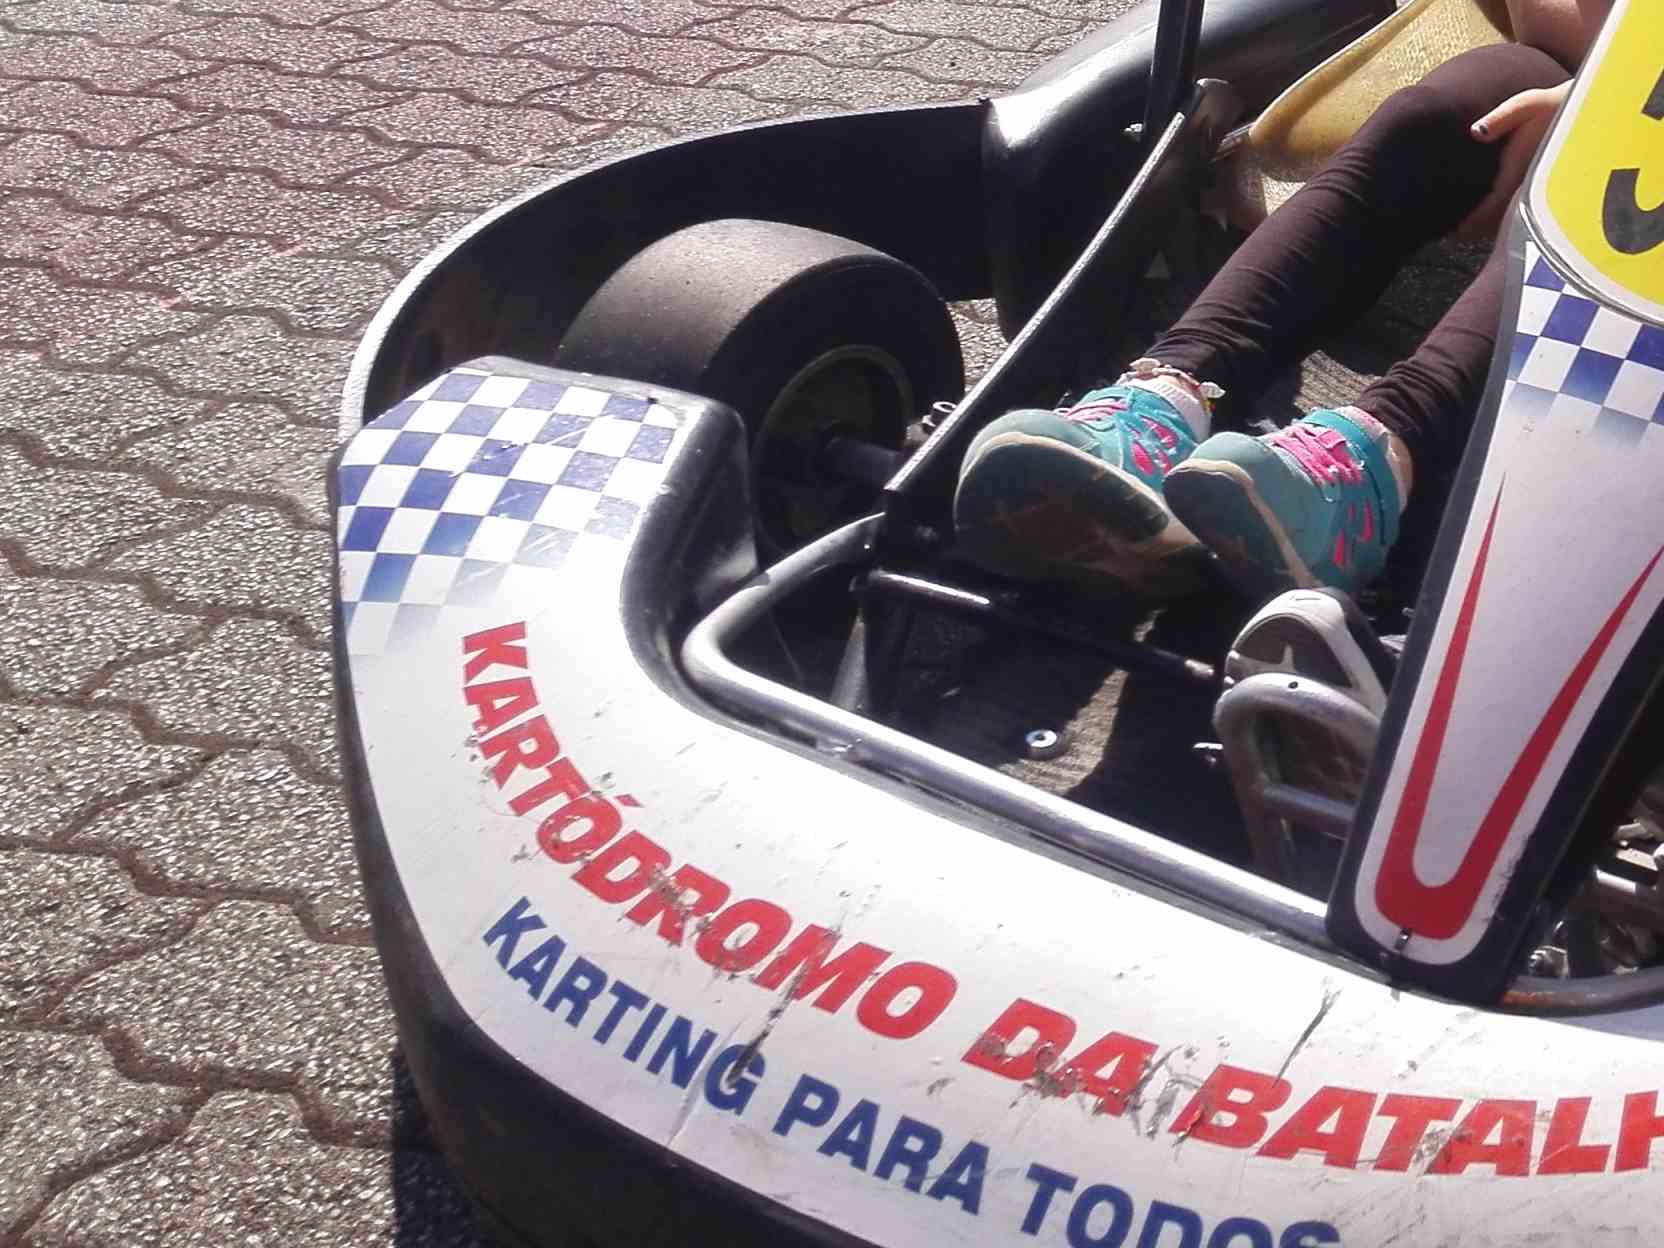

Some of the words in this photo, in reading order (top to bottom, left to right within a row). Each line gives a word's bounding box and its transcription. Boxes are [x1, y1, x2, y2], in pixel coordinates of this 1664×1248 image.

[463, 621, 958, 1039] KARTÓDROMO
[962, 998, 1158, 1117] DA
[482, 897, 766, 1117] KARTING
[773, 1073, 991, 1215] PARA
